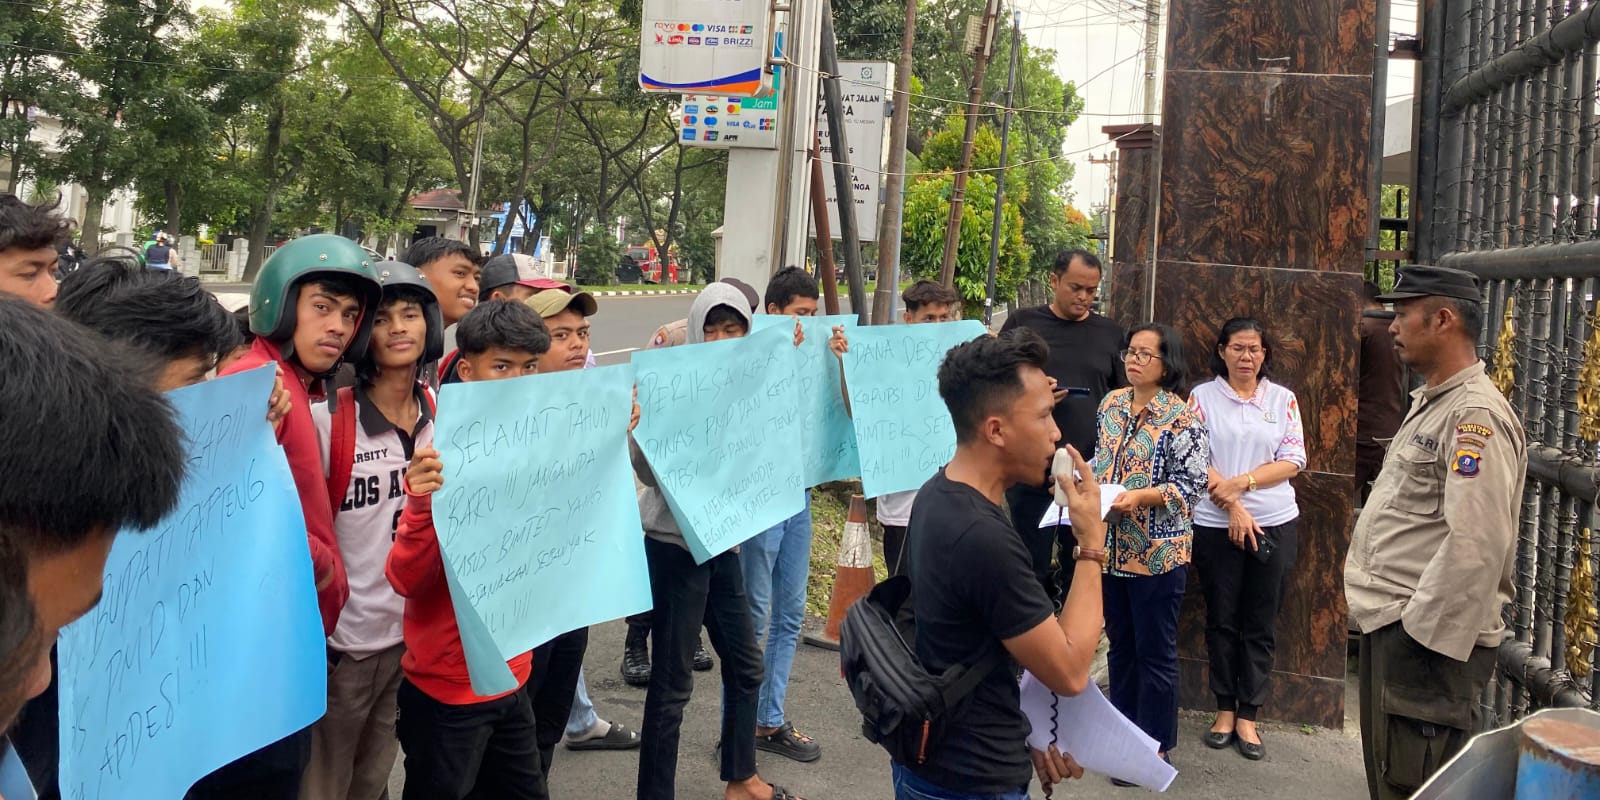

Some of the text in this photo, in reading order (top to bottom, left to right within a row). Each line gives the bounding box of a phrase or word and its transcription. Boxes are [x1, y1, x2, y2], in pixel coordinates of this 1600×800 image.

[753, 99, 773, 109] Jam
[855, 94, 880, 103] JALAN
[851, 339, 895, 372] DANA
[902, 336, 942, 368] DESA
[640, 365, 733, 429] PERIKSA
[854, 385, 904, 408] KORUPSI
[353, 448, 388, 464] RSITY
[452, 402, 610, 478] SELAMAT TAHUN
[340, 475, 380, 512] LOS
[446, 484, 497, 548] BARU
[88, 521, 175, 671] BUPATI
[178, 553, 216, 625] DAN
